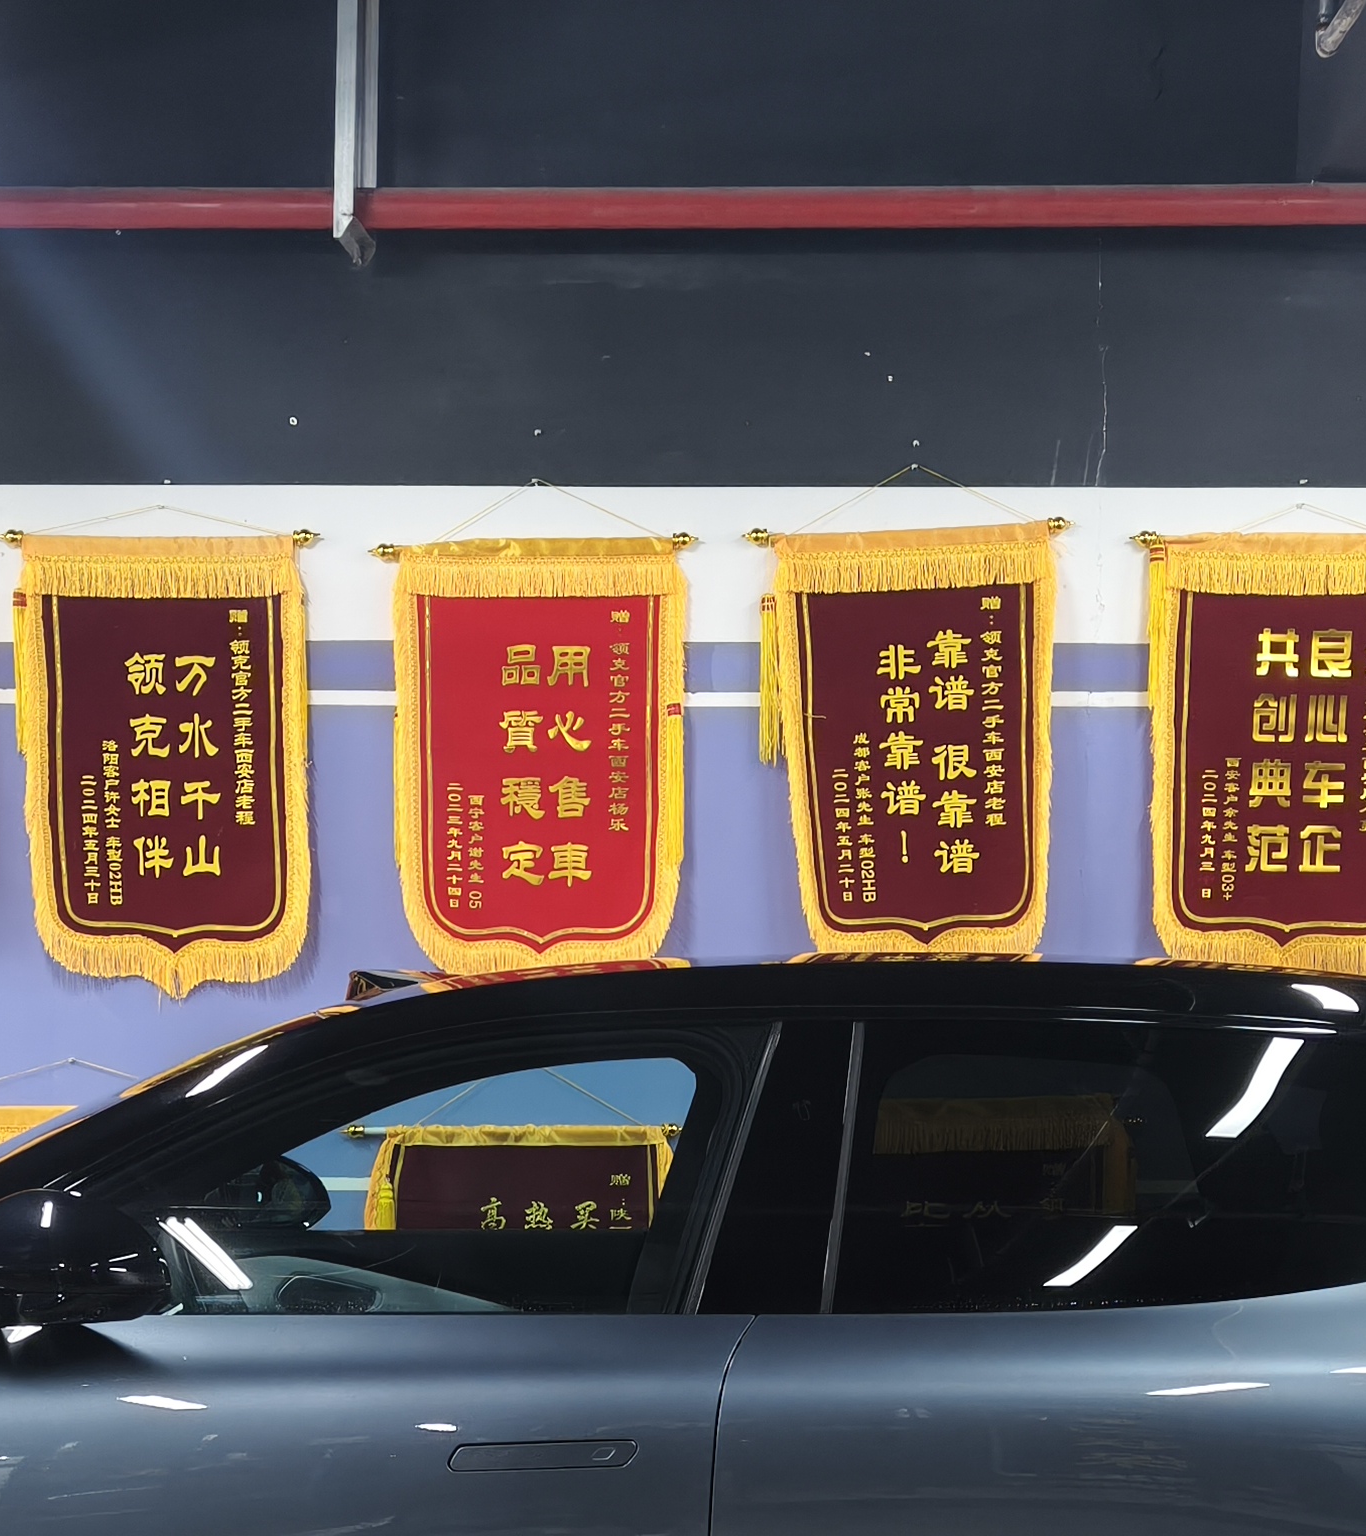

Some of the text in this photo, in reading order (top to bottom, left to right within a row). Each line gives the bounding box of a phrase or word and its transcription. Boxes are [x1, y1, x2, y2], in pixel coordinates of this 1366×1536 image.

[102, 739, 124, 906] 洛阳客户许女士 车型02HB
[124, 651, 175, 879] 领克相伴
[174, 654, 222, 877] 万水千山
[228, 609, 256, 826] 赠：领克官方二手车西安店老程
[499, 643, 545, 886] 品質穩定
[546, 645, 592, 888] 用心售車
[852, 732, 877, 903] 成都客户张先生 车型02HB
[876, 643, 927, 865] 非常靠谱！
[926, 628, 980, 874] 靠谱 很靠谱
[980, 596, 1007, 827] 赠：领克官方二手车西安店老程
[1245, 627, 1300, 873] 共创典范
[1298, 628, 1353, 873] 良心车企
[468, 891, 482, 910] 05
[479, 1196, 507, 1230] 高
[608, 1173, 632, 1230] 赠：陕
